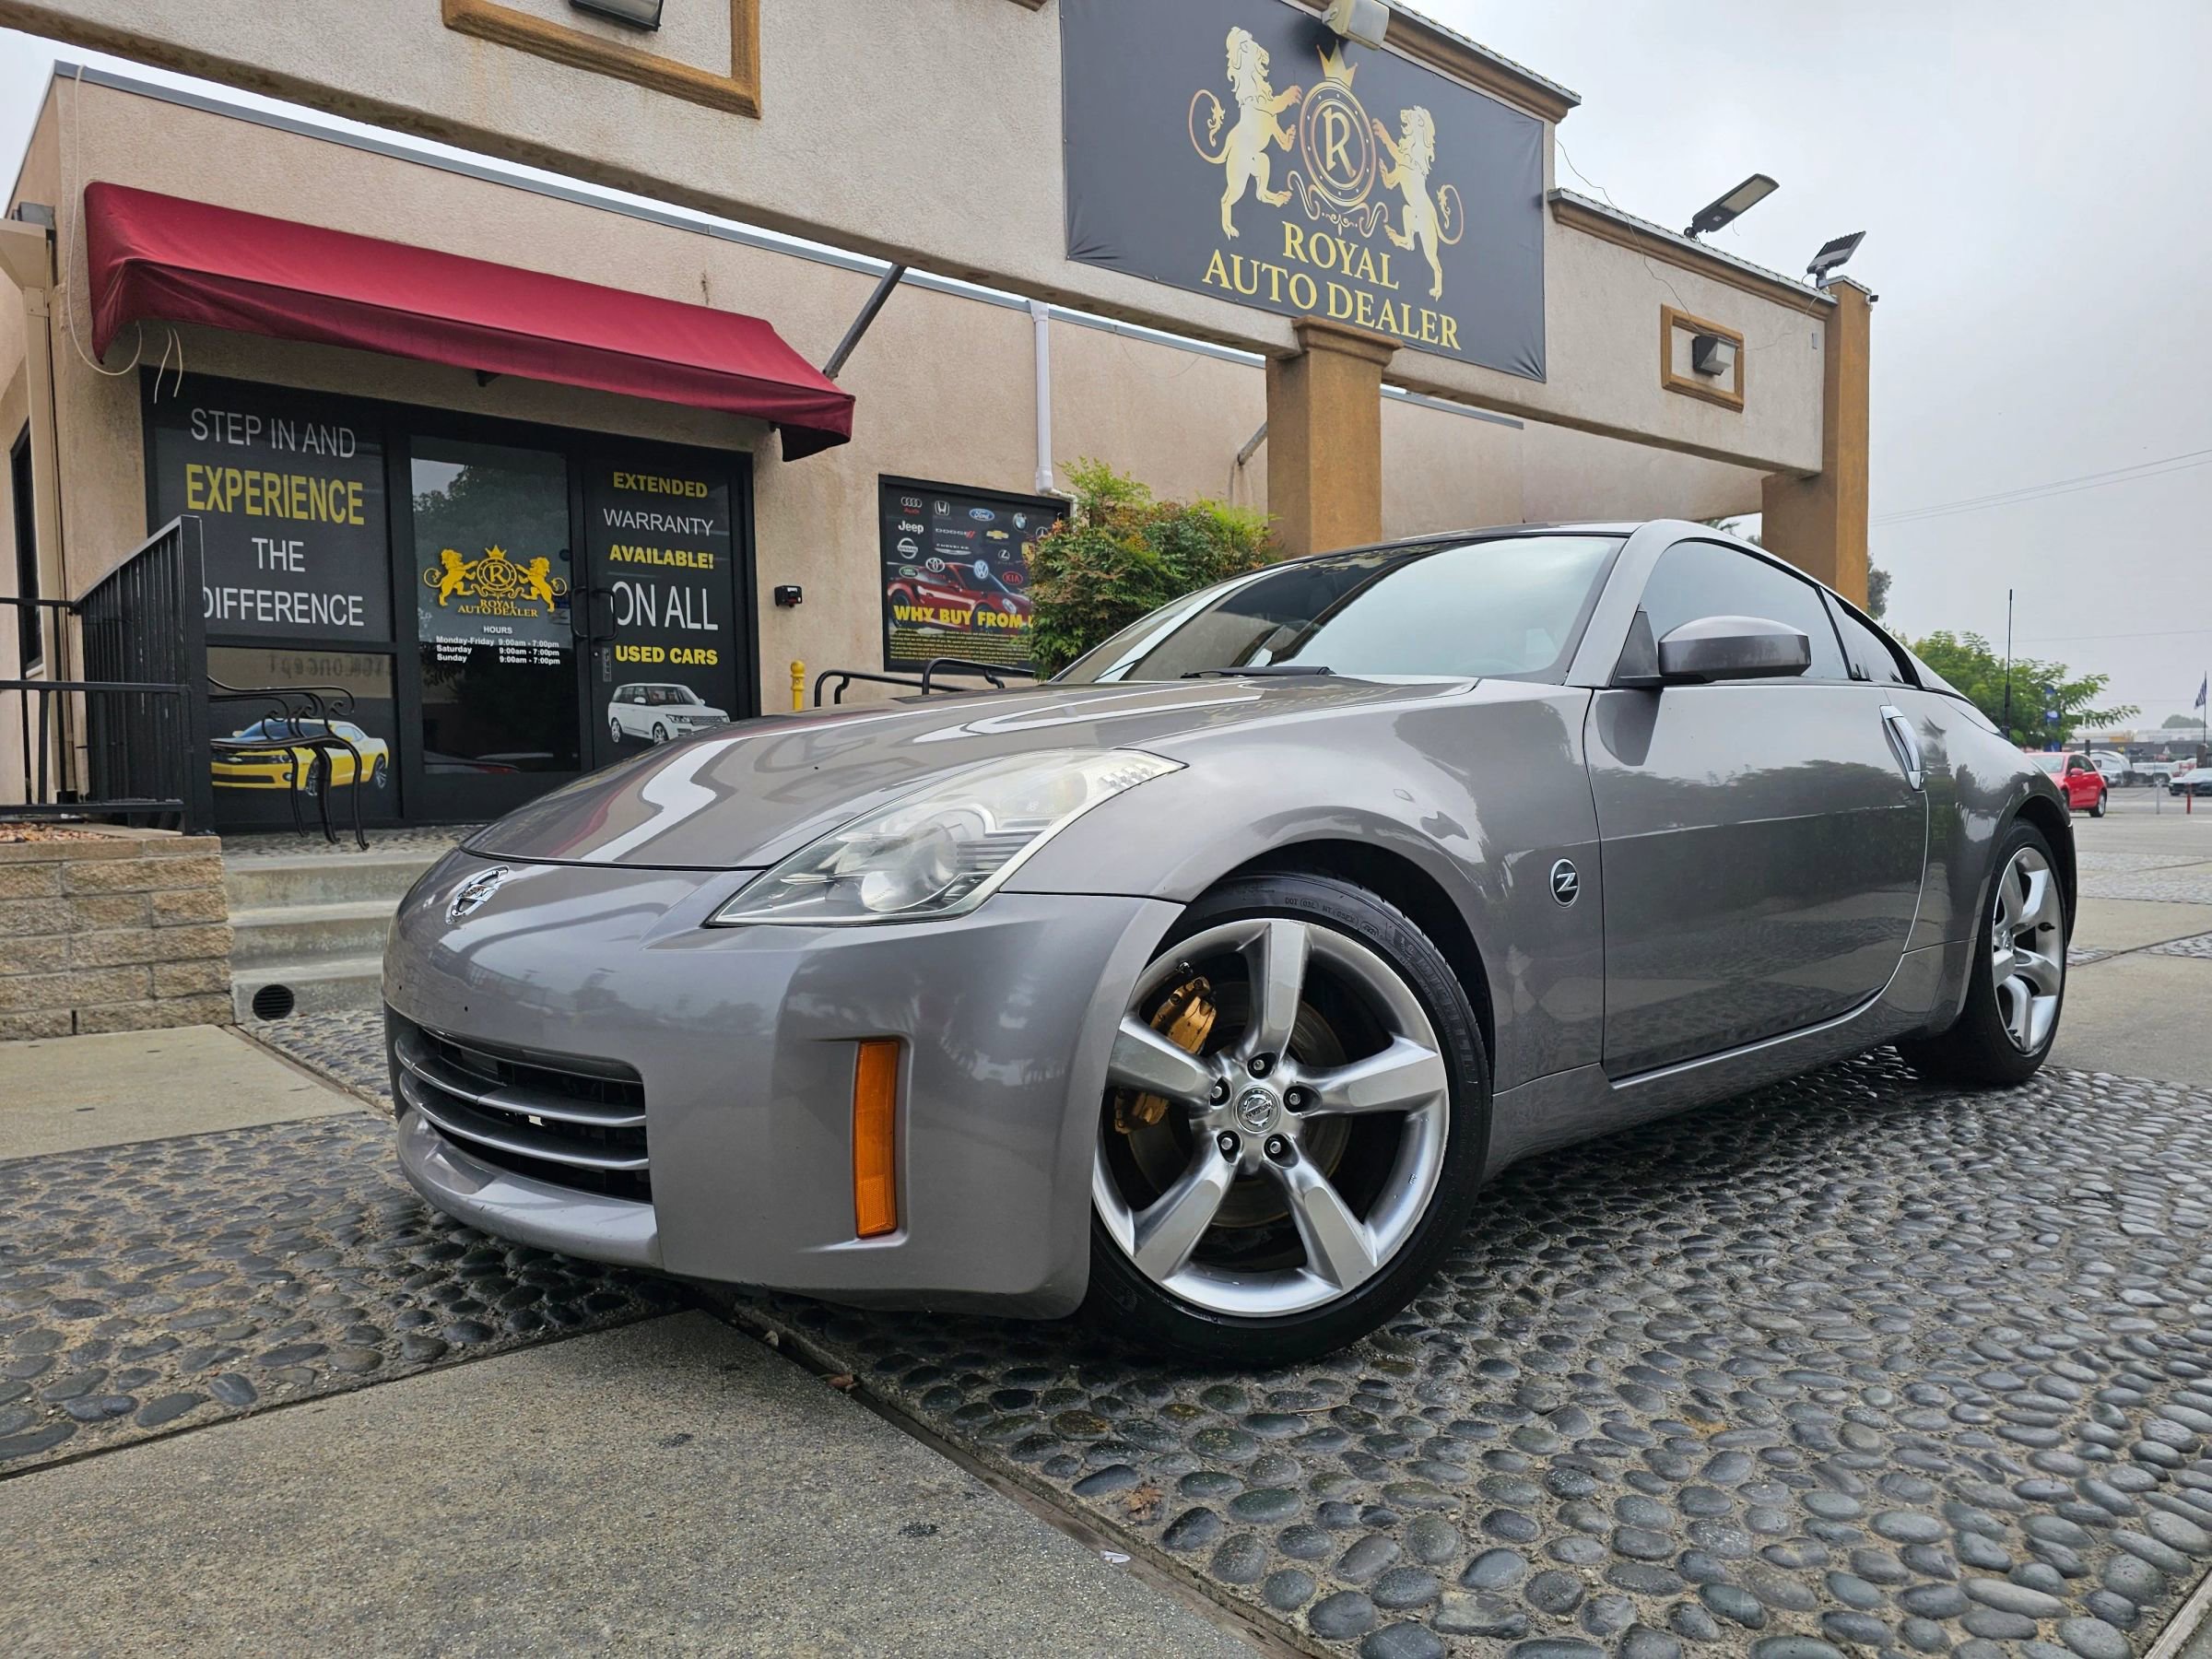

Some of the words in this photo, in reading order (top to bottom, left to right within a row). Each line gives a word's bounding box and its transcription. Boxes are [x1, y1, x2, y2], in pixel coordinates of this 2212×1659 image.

[1322, 106, 1357, 179] R
[1282, 221, 1400, 289] ROYAL
[1202, 249, 1318, 310] AUTO
[1326, 281, 1462, 351] DEALER
[191, 407, 263, 446] STEP
[271, 418, 296, 452] IN
[301, 422, 356, 458] AND
[186, 464, 365, 525] EXPERIENCE
[613, 471, 708, 499] EXTENDED
[603, 508, 714, 536] WARRANTY
[898, 520, 924, 535] Jeep
[251, 537, 306, 572] THE
[609, 544, 714, 570] AVAILABLE!
[488, 564, 508, 583] R
[1005, 574, 1019, 582] KIA
[203, 586, 364, 627] DIFFERENCE
[457, 605, 491, 615] AUTO
[494, 607, 538, 618] DEALER
[479, 599, 518, 609] ROYAL
[610, 581, 656, 627] ON
[665, 585, 719, 630] ALL
[893, 605, 935, 623] WHY
[939, 607, 972, 626] BUY
[977, 611, 1023, 629] FROM
[483, 626, 513, 634] HOURS
[436, 636, 495, 647] Monday-Friday
[498, 638, 526, 647] 9:00am
[532, 640, 559, 649] 7:00pm
[436, 644, 473, 655] Saturday
[533, 649, 560, 657] 7:00pm
[616, 644, 665, 663] USED
[669, 647, 719, 665] CARS
[437, 653, 467, 663] Sunday
[499, 655, 527, 664] 9:00am
[533, 657, 561, 665] 7:00pm
[1556, 872, 1578, 893] Z
